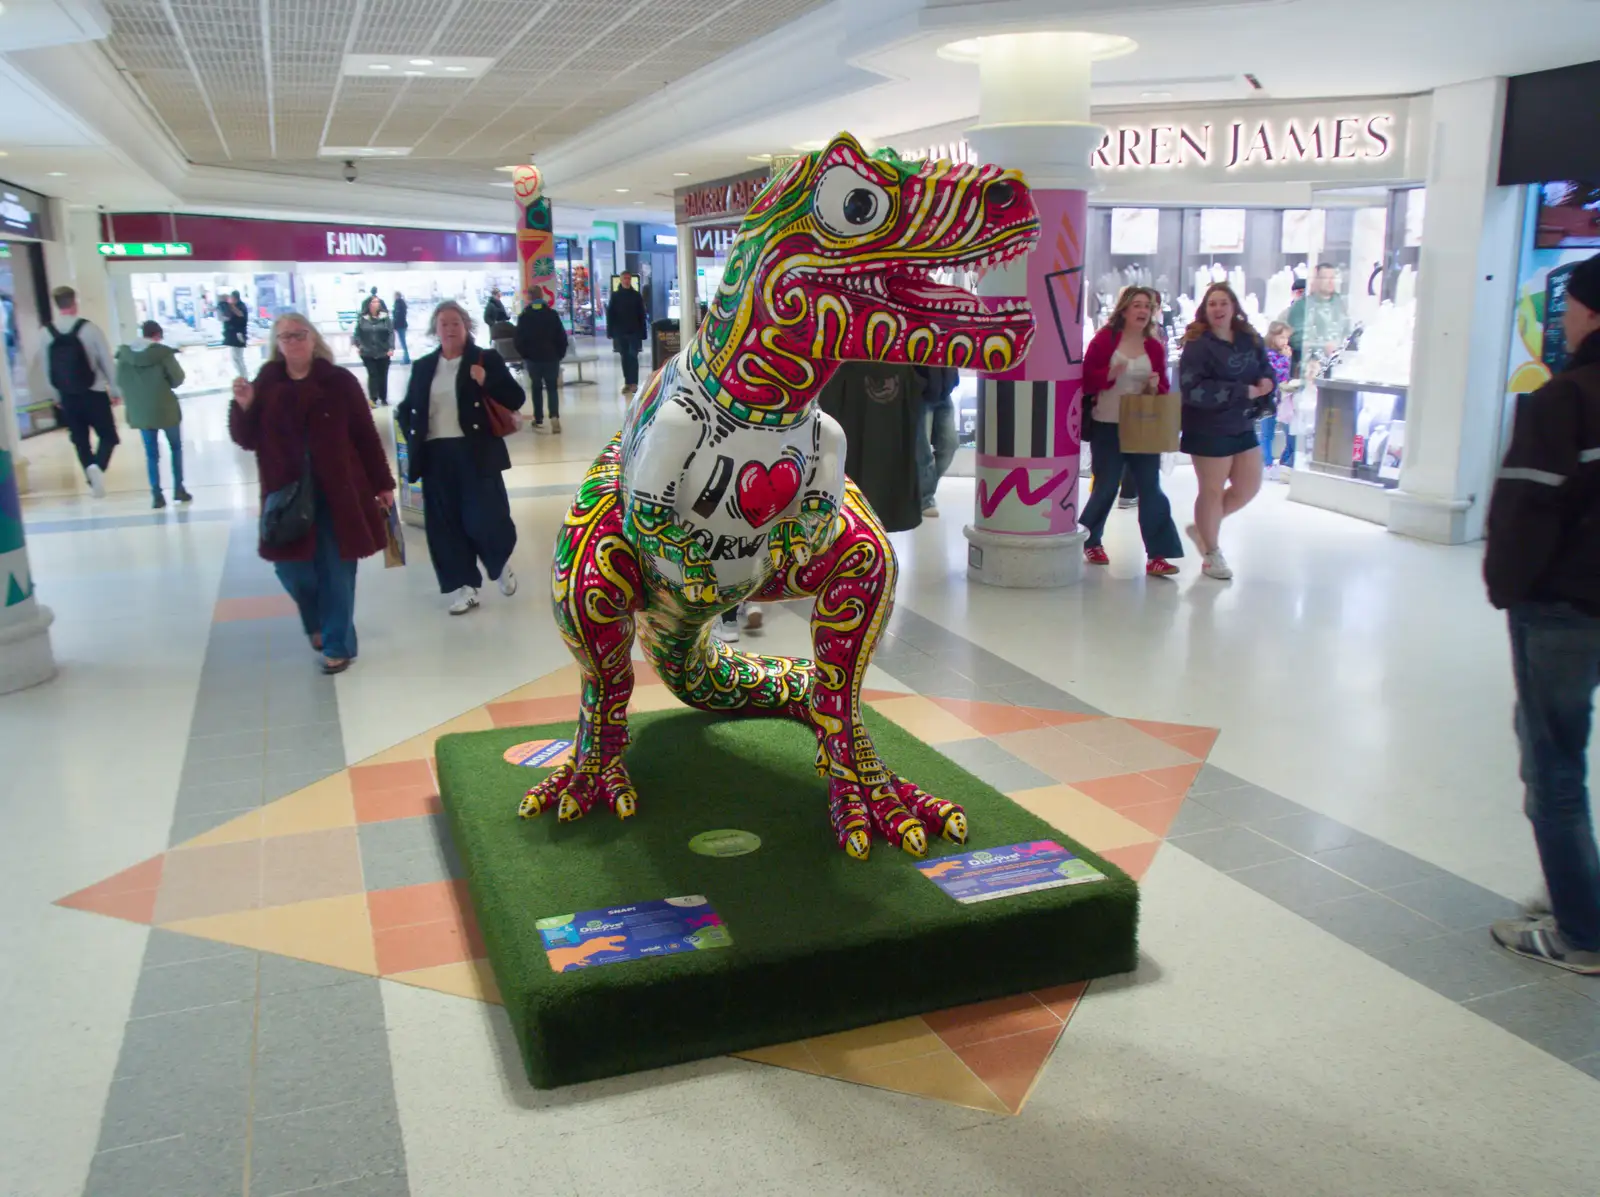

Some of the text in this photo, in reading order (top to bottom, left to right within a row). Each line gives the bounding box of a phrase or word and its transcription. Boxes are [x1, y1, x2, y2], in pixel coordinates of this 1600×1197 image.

[1224, 115, 1391, 168] JAMES
[684, 184, 728, 217] BAKERY
[326, 231, 387, 257] F.HINDS
[691, 454, 735, 520] I
